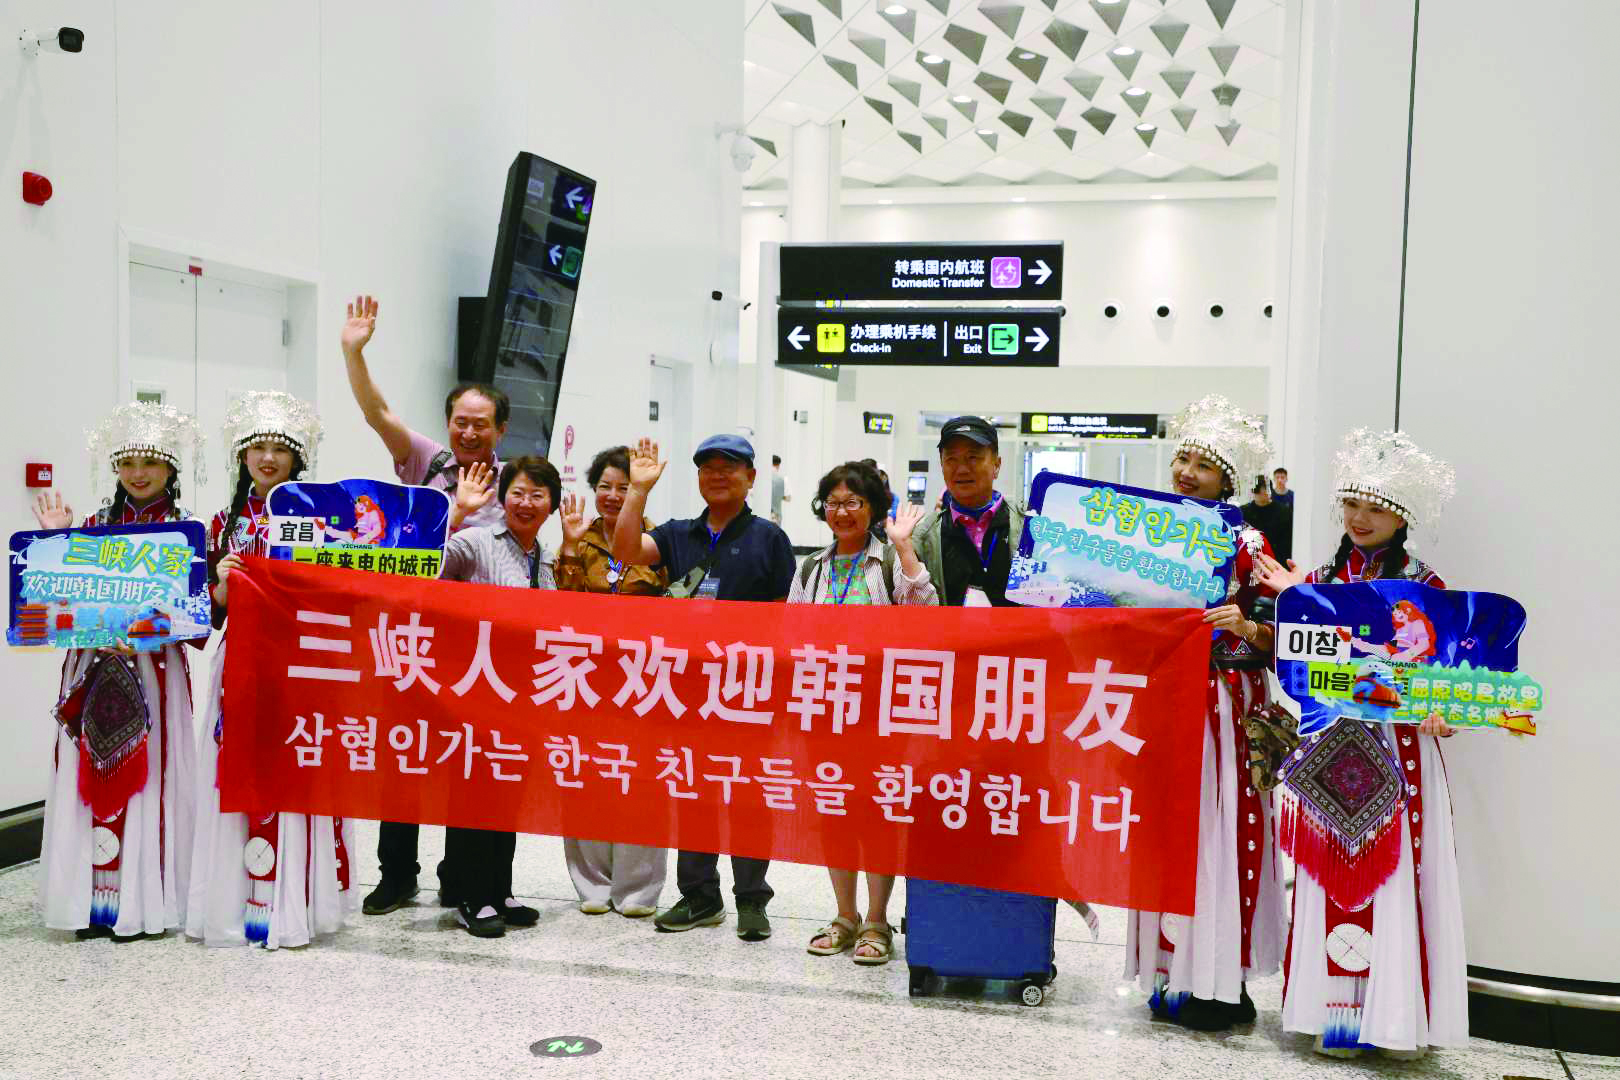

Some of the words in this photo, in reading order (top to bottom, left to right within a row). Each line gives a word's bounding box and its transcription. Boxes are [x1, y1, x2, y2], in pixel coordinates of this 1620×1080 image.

[895, 260, 984, 276] 转乘国内航班
[892, 278, 940, 288] Domestic
[941, 278, 984, 288] Transfer
[850, 324, 936, 340] 办理乘机手续
[954, 325, 983, 340] 出口
[850, 343, 891, 353] Check-in
[963, 344, 982, 354] Exit
[279, 521, 314, 542] 宜昌
[1087, 491, 1232, 563] 삼협인가는
[65, 536, 193, 576] 三峡人家
[295, 551, 441, 577] 一座来电的城市
[26, 575, 164, 602] 欢迎韩国朋友
[1288, 629, 1341, 656] 이창
[287, 608, 1149, 757] 三峡人家欢迎韩国朋友
[285, 712, 529, 782] 삼협인가는
[543, 734, 638, 795] 한국
[655, 746, 855, 816] 친구들을
[872, 763, 1141, 853] 환영합니다
